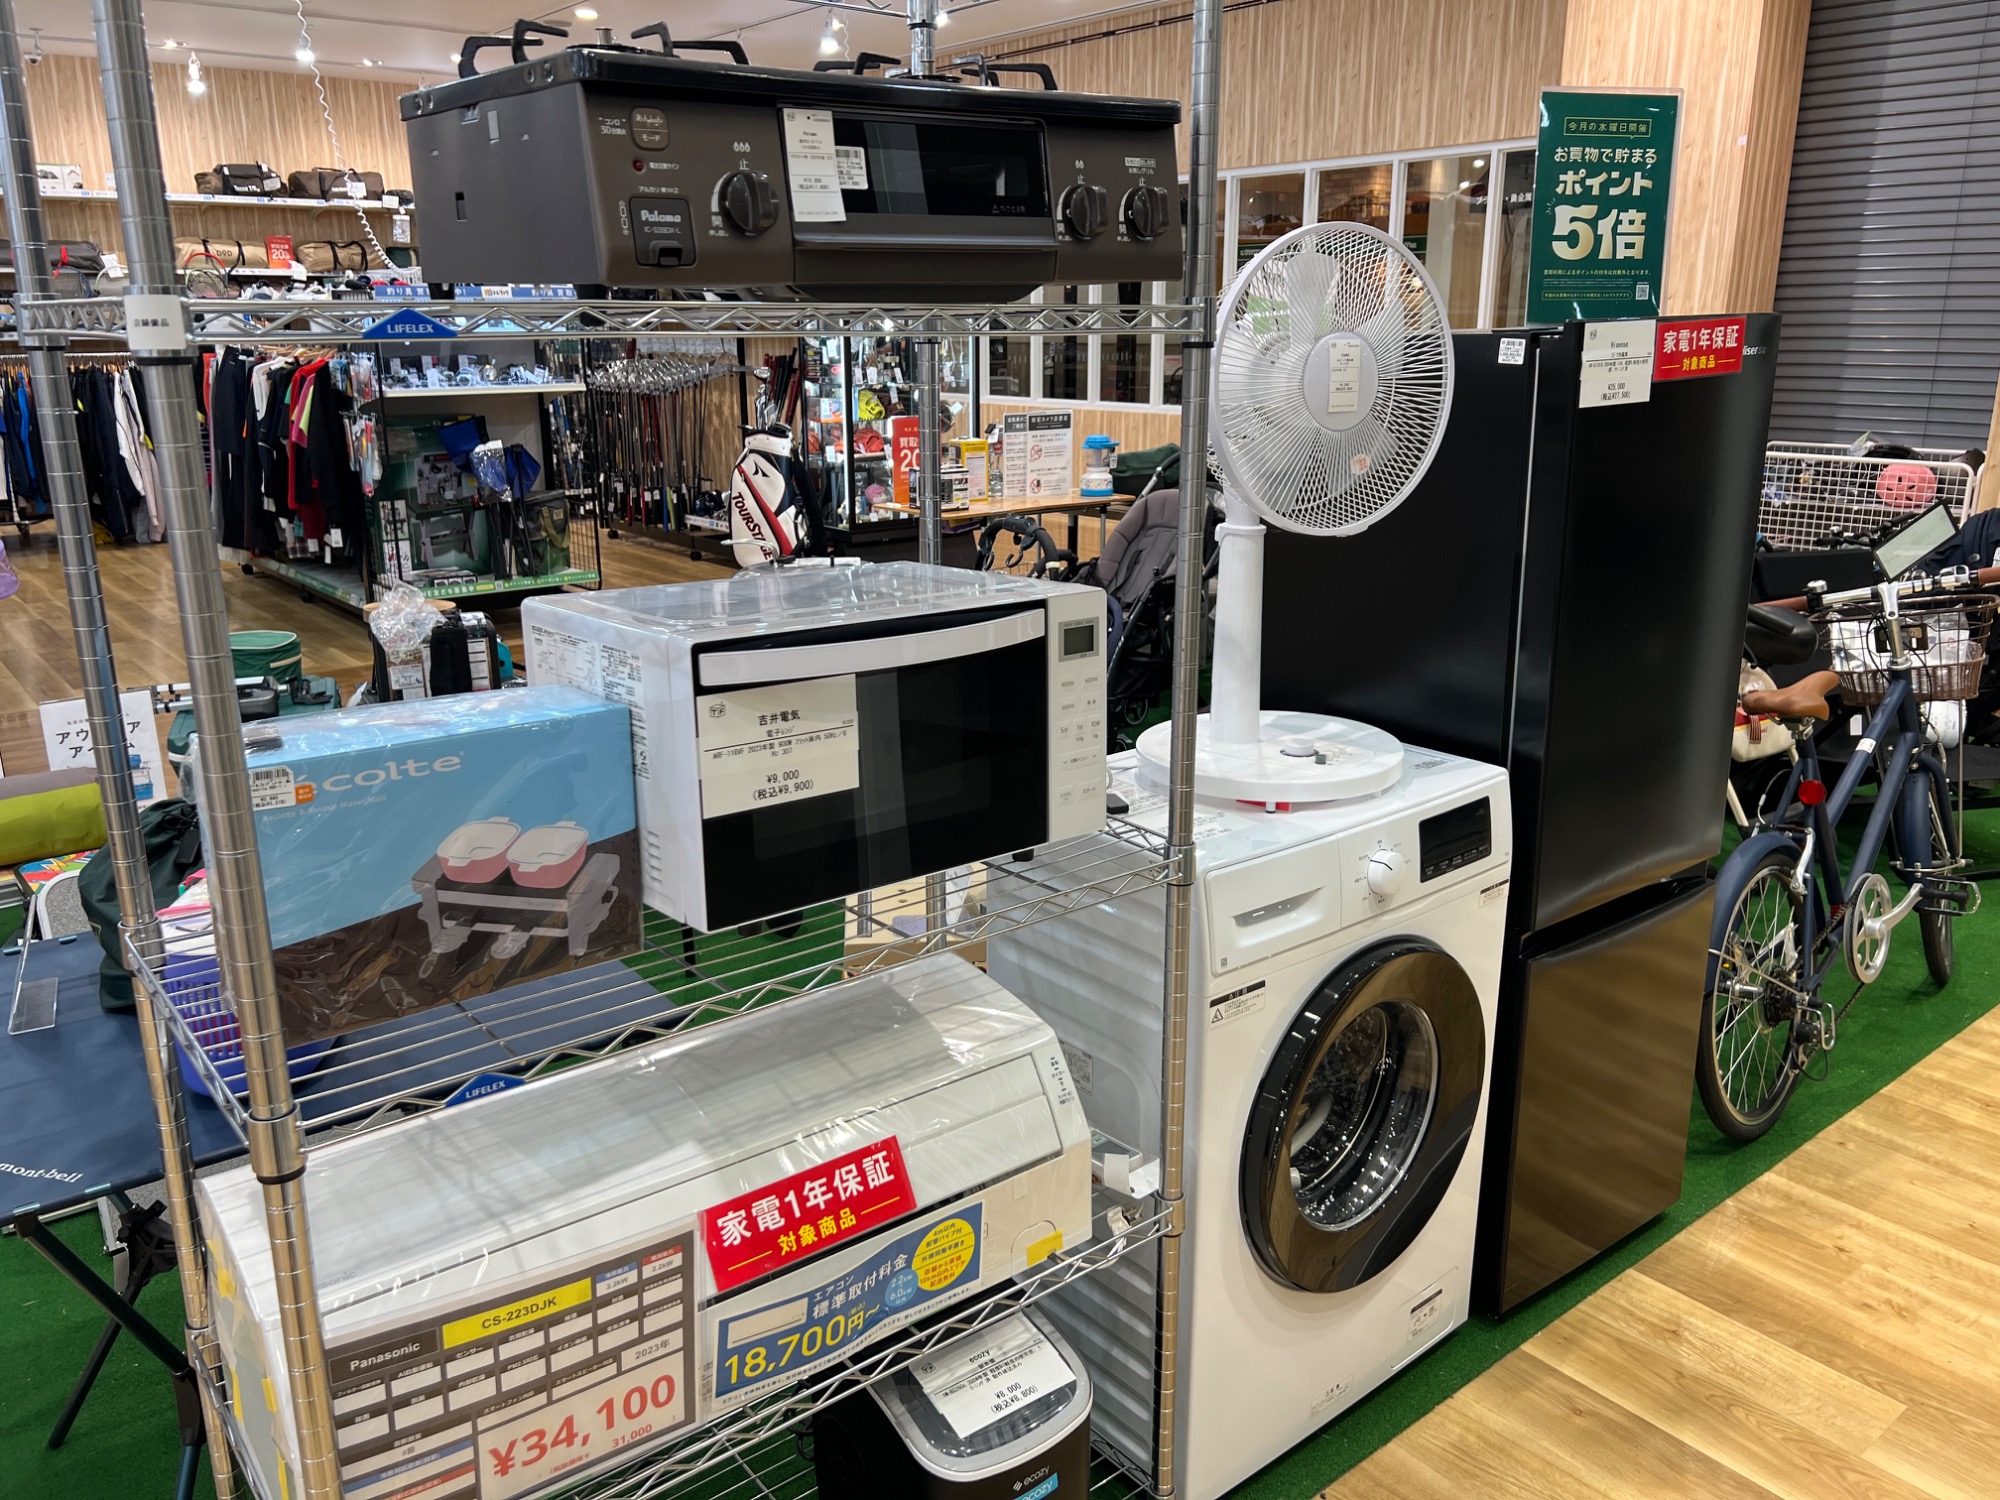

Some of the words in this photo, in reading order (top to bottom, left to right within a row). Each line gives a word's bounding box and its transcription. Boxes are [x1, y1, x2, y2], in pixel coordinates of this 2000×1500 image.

[1568, 121, 1648, 133] 今月の水曜日開催
[739, 159, 750, 170] 止
[1554, 147, 1657, 164] お買物で貯まる
[1077, 174, 1085, 184] 止
[1138, 177, 1147, 187] 止
[1555, 169, 1653, 196] ポイント
[640, 209, 682, 223] Paloma
[1551, 204, 1647, 261] 5倍
[387, 323, 434, 334] LIFELEX
[1663, 325, 1740, 354] 家電1年保証
[1681, 354, 1715, 371] 対象商品
[899, 437, 919, 448] 買取
[758, 709, 800, 726] 吉井電気
[56, 720, 141, 744] アウア
[766, 725, 796, 738] 電子レンジ
[748, 741, 775, 754] 2023年製
[767, 769, 800, 785] ¥9,000
[753, 779, 814, 801] (税込¥9,900)
[465, 1080, 506, 1099] LIFELEX
[716, 1150, 895, 1247] 家電1年保証
[778, 1208, 857, 1256] 対象商品
[926, 1227, 962, 1248] 配管パイプ付
[651, 1259, 674, 1273] 2.2kW
[606, 1276, 629, 1290] 2.2kW
[812, 1253, 909, 1320] 標準取付料金
[813, 1275, 855, 1300] エアコン
[482, 1296, 557, 1330] CS-223DJK
[349, 1342, 421, 1372] Panasonic
[635, 1338, 670, 1360] 2023年
[969, 1349, 991, 1363] ecozy
[556, 1358, 614, 1386] スマートスピーカー対応
[990, 1385, 1039, 1413] (税込¥8,800)
[994, 1382, 1022, 1400] ¥8,000
[483, 1390, 535, 1415] スマートフォン対応
[488, 1374, 676, 1477] ¥34,100
[612, 1424, 653, 1449] 31,000
[1023, 1465, 1050, 1486] ecozy
